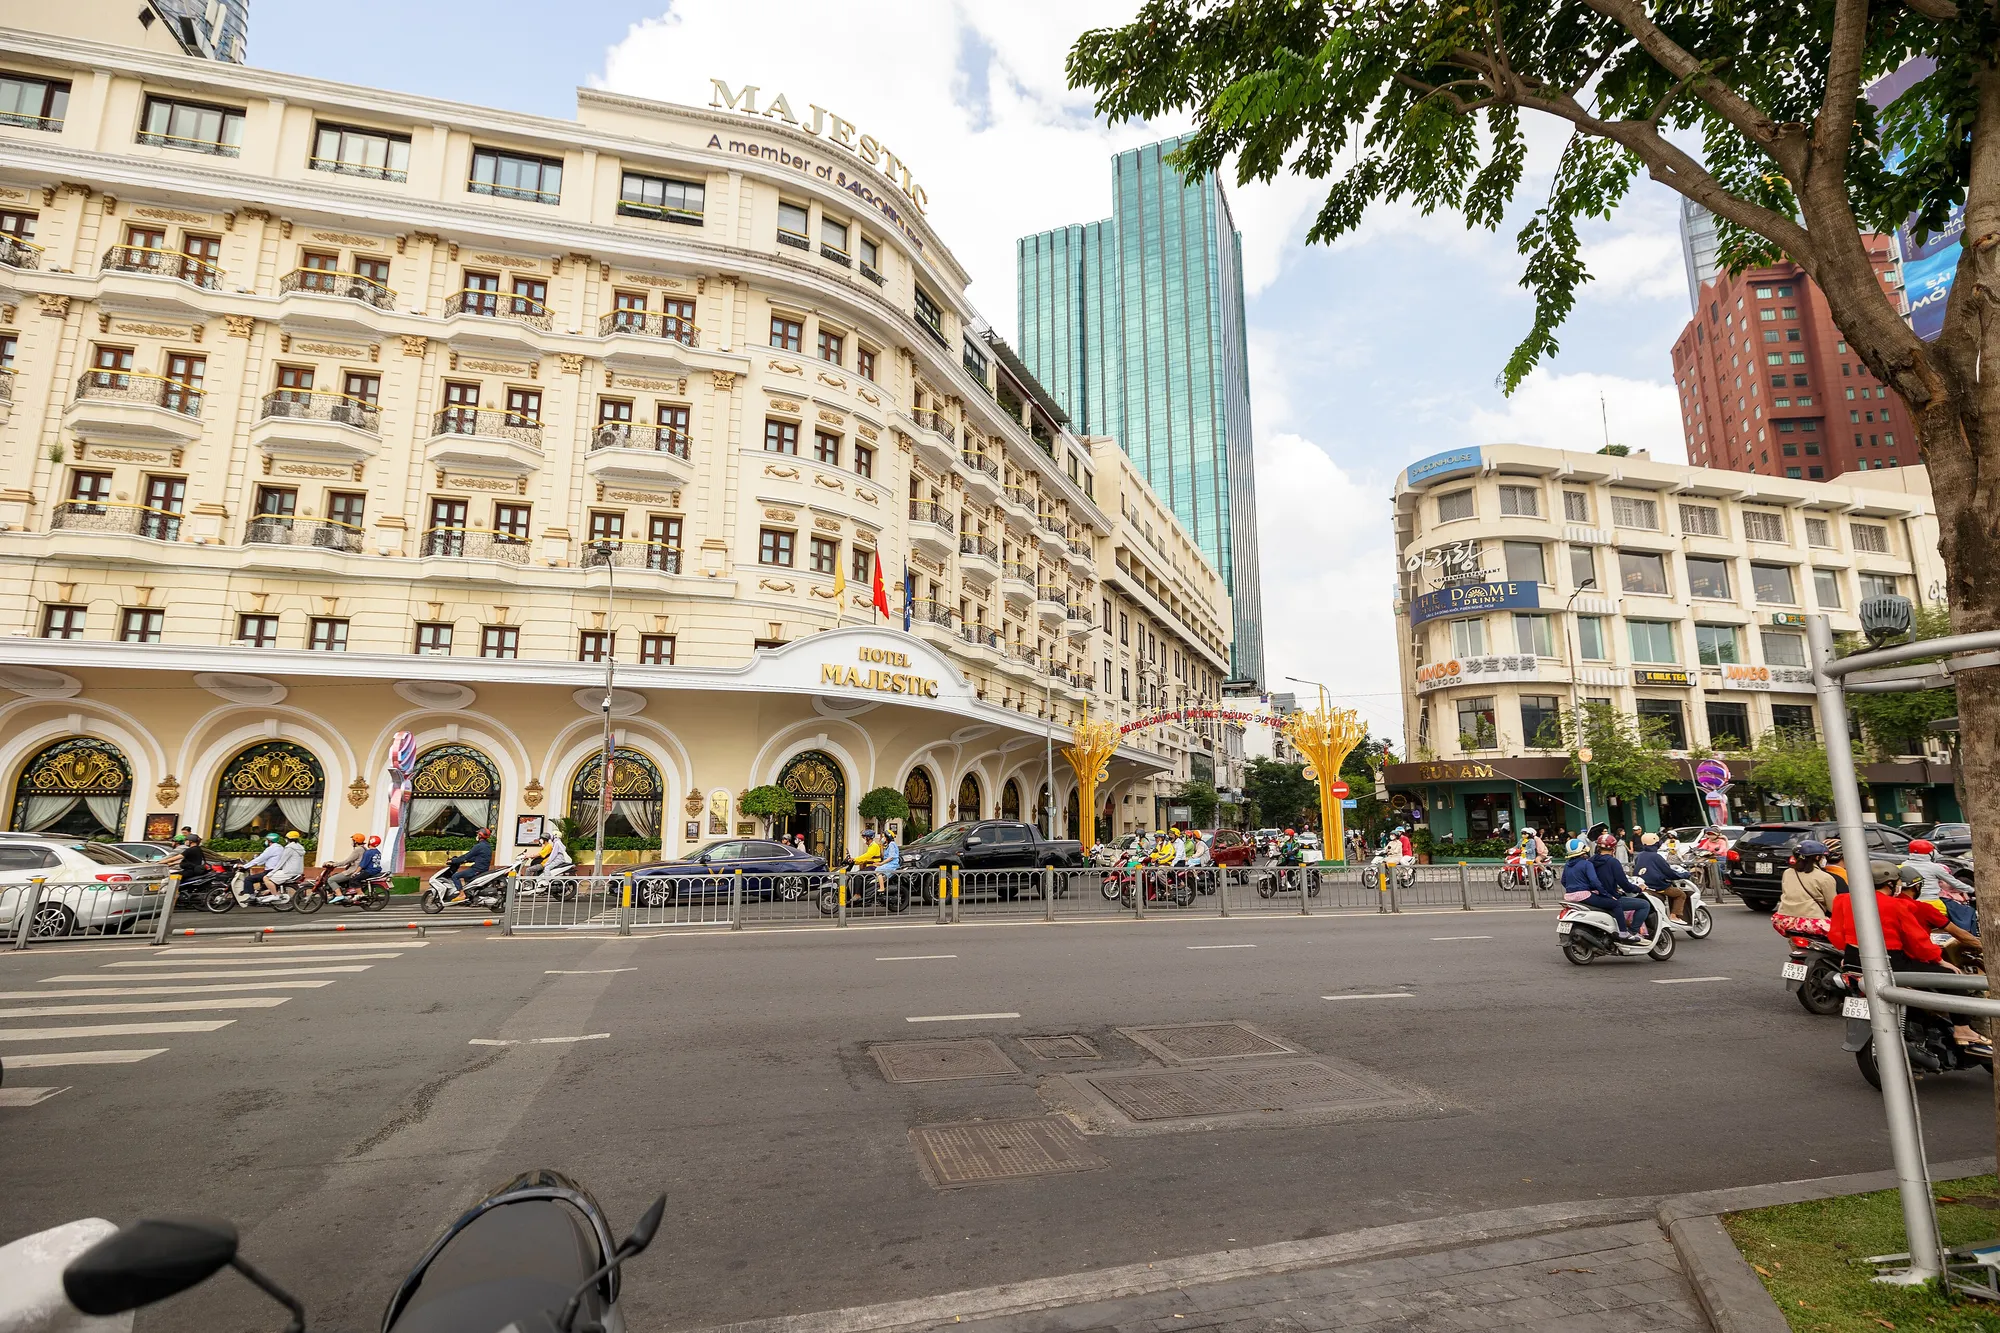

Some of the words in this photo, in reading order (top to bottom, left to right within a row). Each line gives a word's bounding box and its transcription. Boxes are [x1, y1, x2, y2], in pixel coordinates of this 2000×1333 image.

[708, 78, 928, 216] MAJESTIC
[707, 134, 722, 149] A
[729, 140, 811, 172] member
[816, 166, 832, 181] of
[1411, 453, 1472, 477] SAIGONHOUSE
[1460, 568, 1500, 579] RESTAURANT
[1463, 596, 1505, 606] DRINKS
[859, 646, 912, 668] HOTEL
[821, 663, 939, 699] MAJESTIC
[1426, 676, 1462, 689] SEAFOOD
[1672, 673, 1687, 681] TEA
[1737, 681, 1770, 689] SEAFOOD
[1844, 1006, 1868, 1018] 865.7
